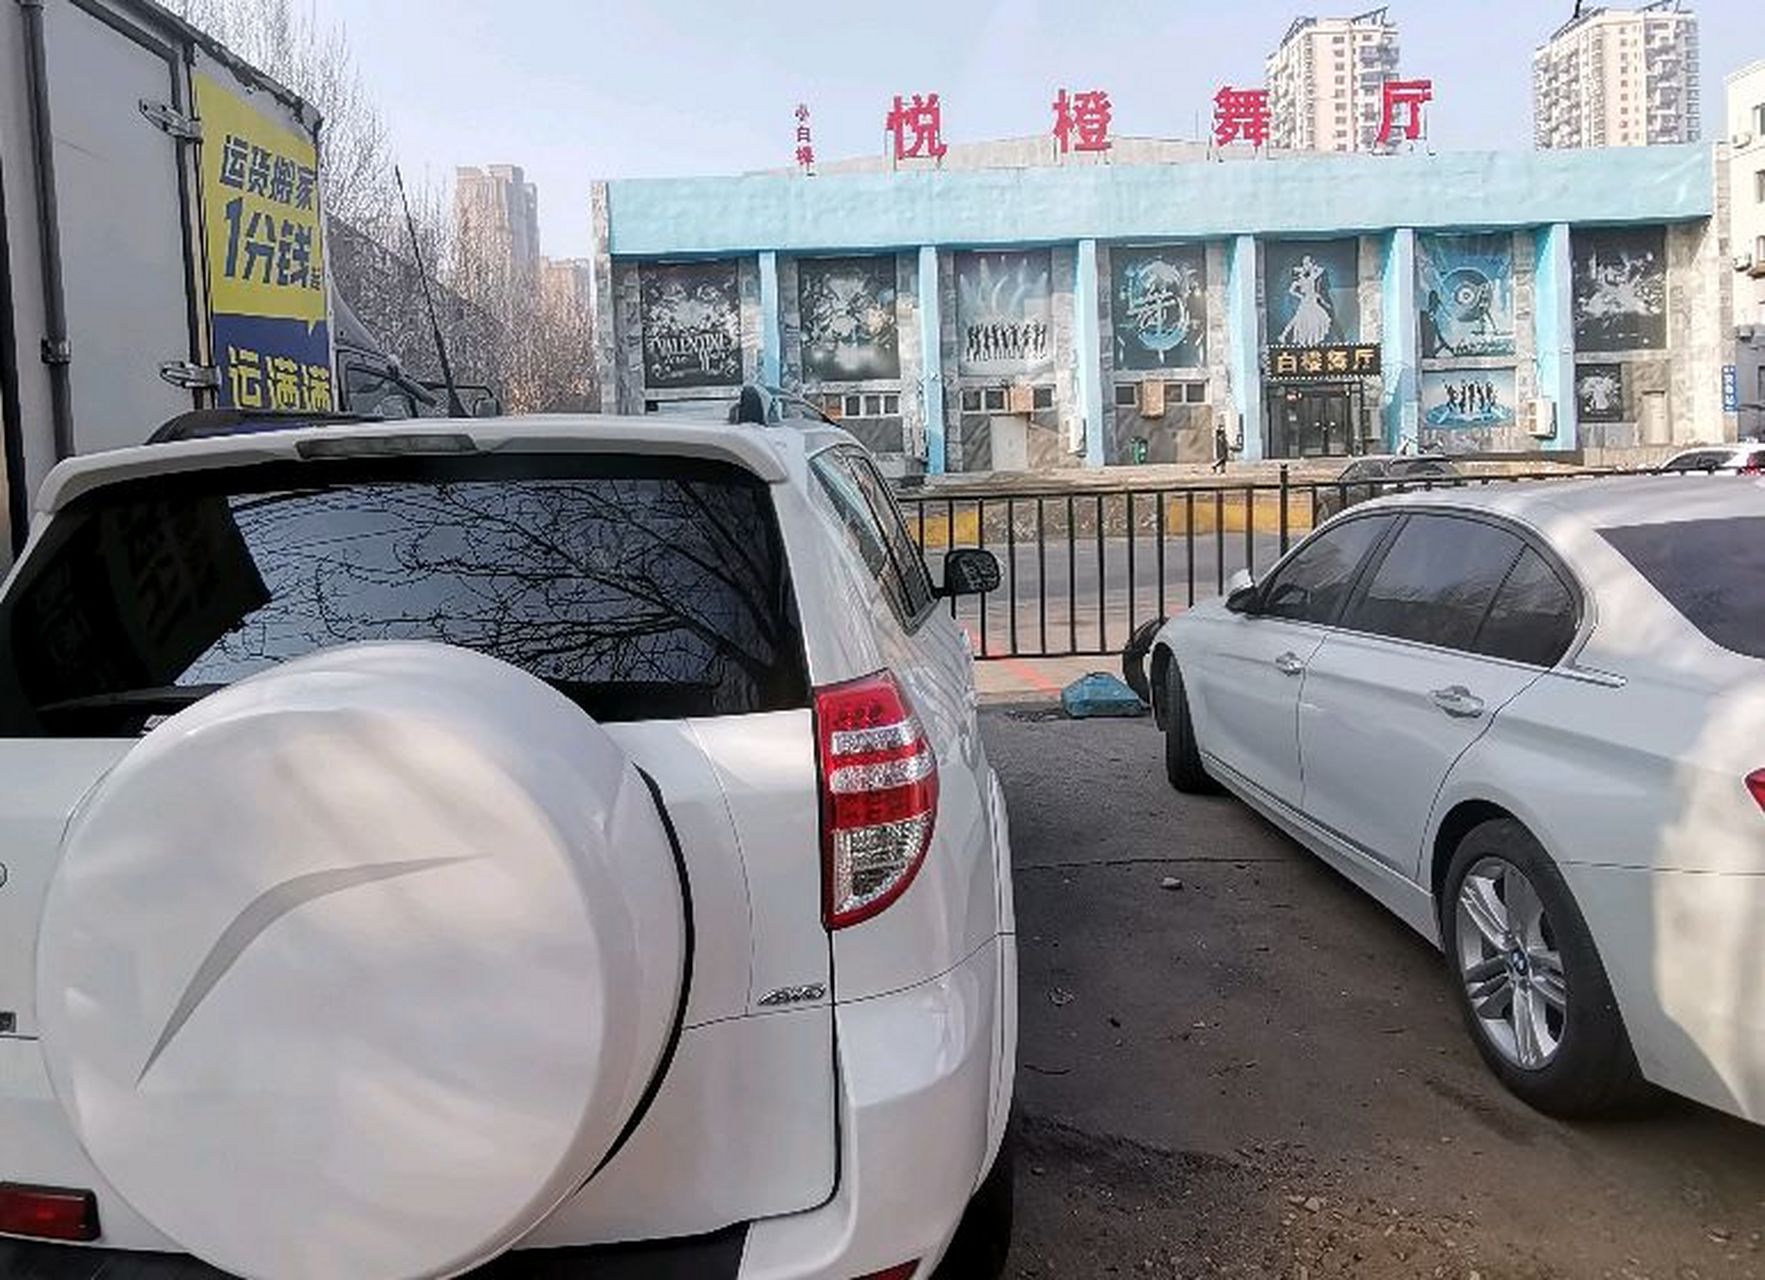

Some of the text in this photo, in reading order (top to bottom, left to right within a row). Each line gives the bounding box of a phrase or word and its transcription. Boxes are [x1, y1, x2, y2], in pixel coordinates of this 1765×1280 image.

[886, 80, 1432, 160] 悦橙舞厅
[219, 134, 315, 211] 运货搬家
[228, 345, 331, 412] 运满满
